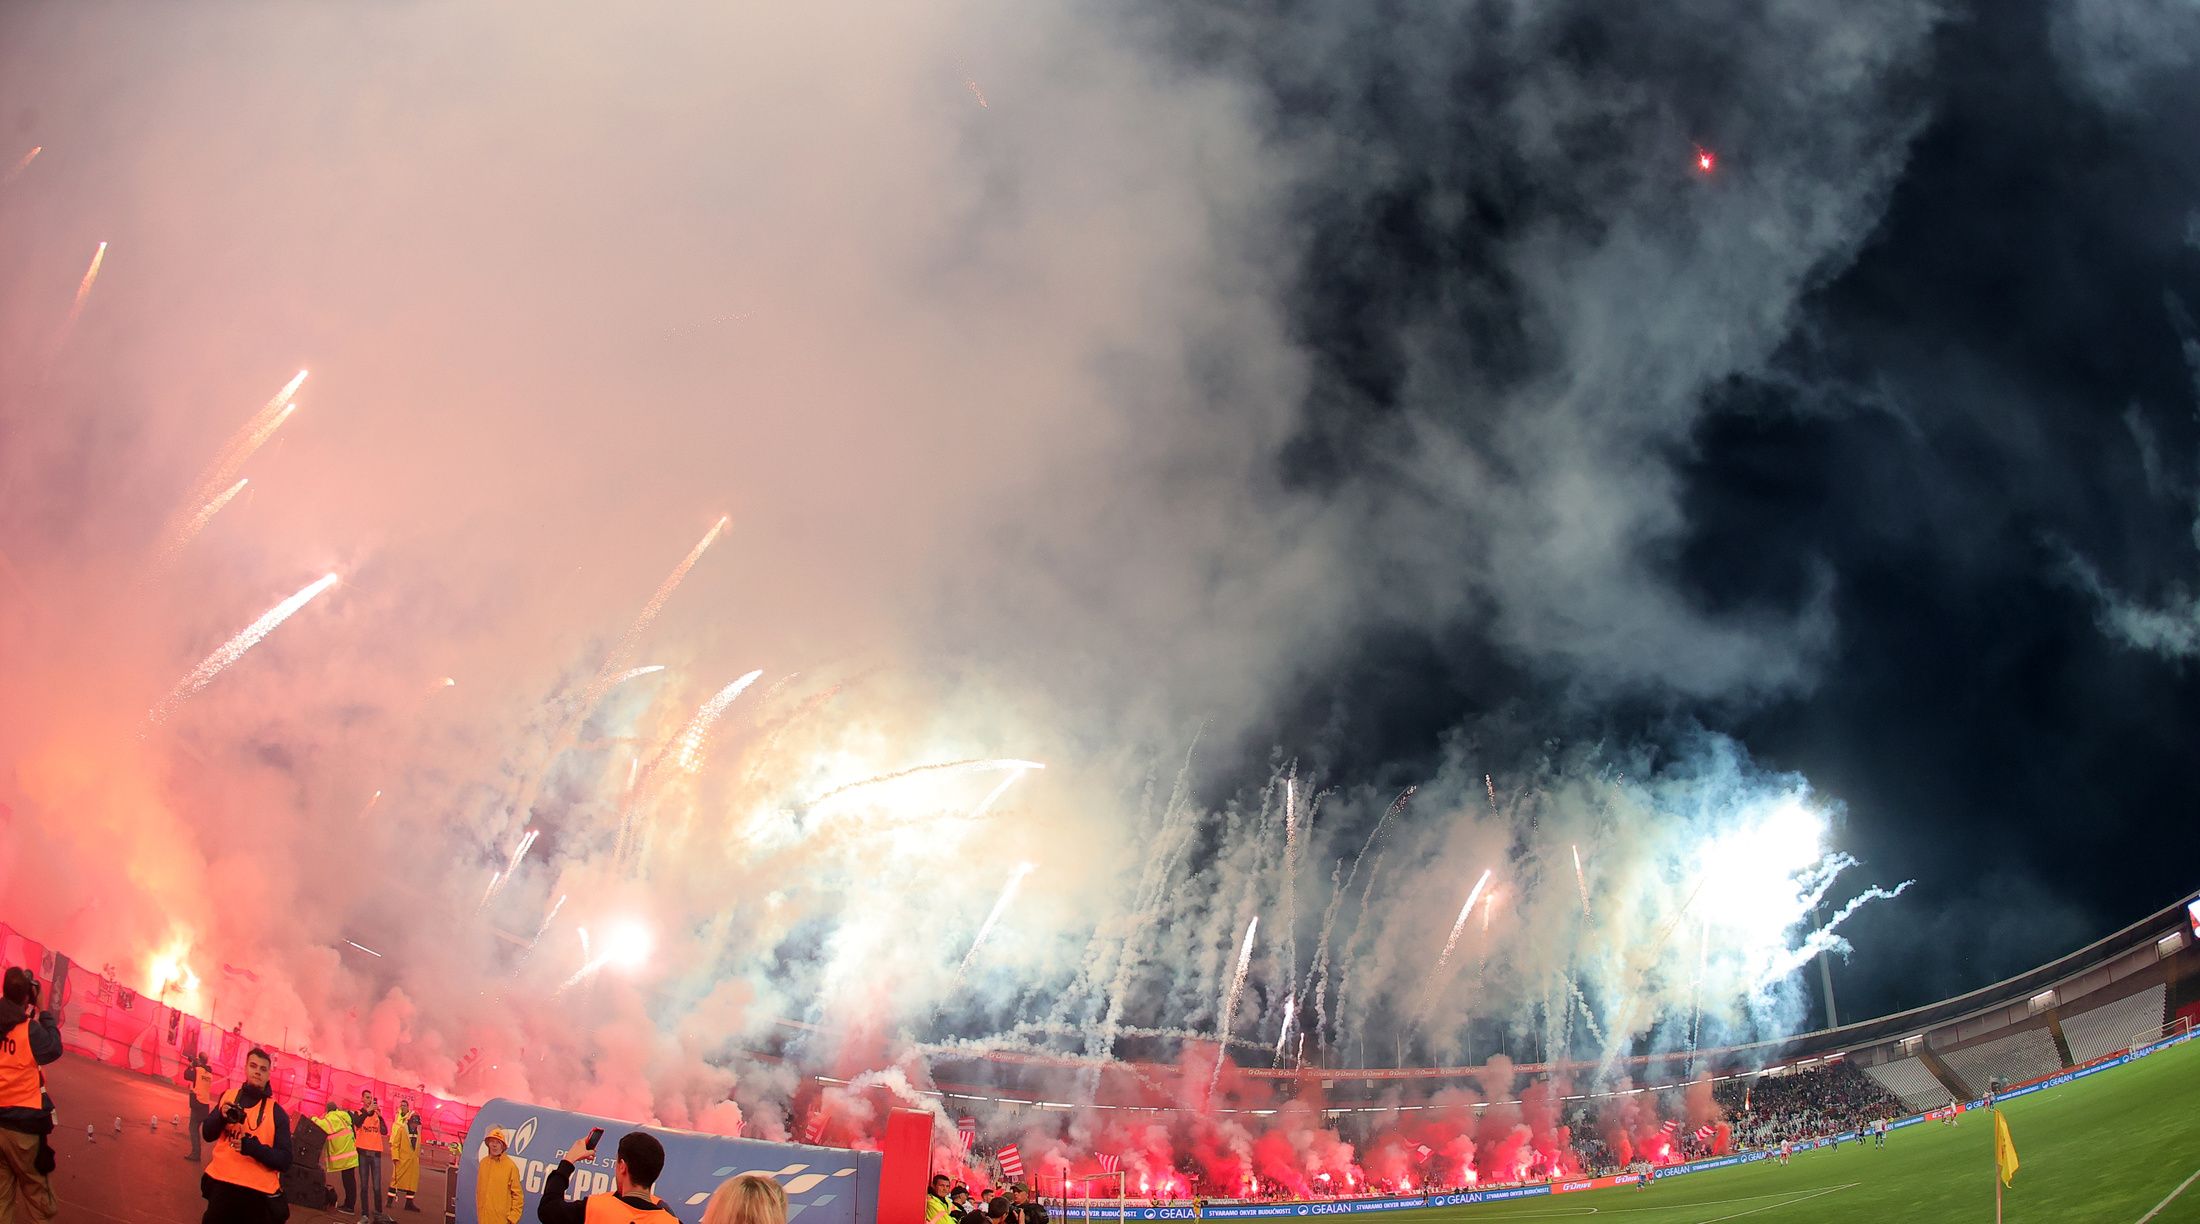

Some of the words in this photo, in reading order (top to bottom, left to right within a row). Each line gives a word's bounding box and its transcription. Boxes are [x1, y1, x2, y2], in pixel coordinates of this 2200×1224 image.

[1664, 1165, 1690, 1176] GEALAN
[1447, 1192, 1482, 1205] GEALAN
[1048, 1208, 1080, 1217] STVAAMO
[1081, 1209, 1099, 1217] OVIR
[1101, 1207, 1137, 1217] BUDUĆOSTI
[1312, 1203, 1351, 1214] GEALAN
